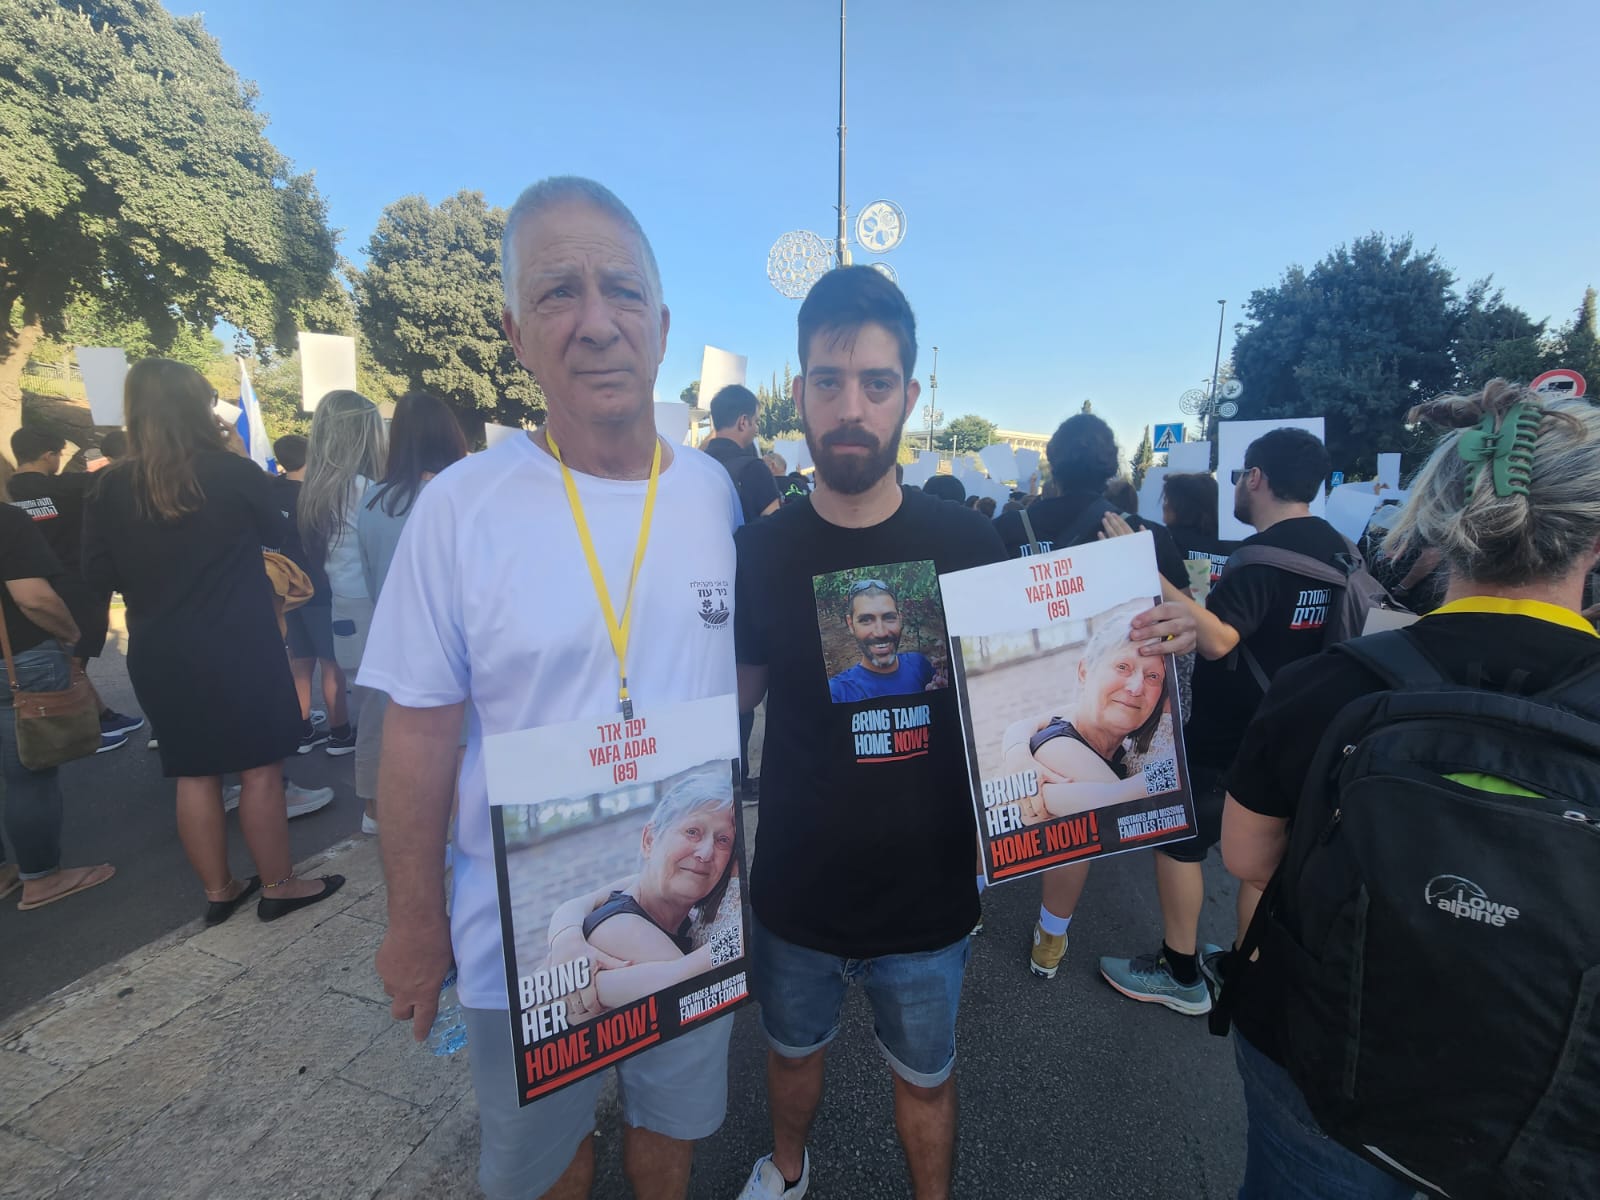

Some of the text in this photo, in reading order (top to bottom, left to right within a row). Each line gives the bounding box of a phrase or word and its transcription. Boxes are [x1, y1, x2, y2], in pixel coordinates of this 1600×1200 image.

[1029, 557, 1073, 582] יפה אדר
[697, 588, 713, 599] עוז
[1025, 575, 1085, 605] YAFA ADAR
[1047, 598, 1070, 621] (85)
[597, 718, 646, 743] יפה אדר
[851, 704, 931, 733] BRING TAMIR
[589, 736, 657, 767] YAFA ADAR
[854, 726, 929, 756] HOME NOW!
[613, 760, 638, 785] (85)
[982, 768, 1038, 809] BRING
[985, 803, 1023, 837] HER
[1117, 804, 1185, 827] HOSTAGES AND MISSING
[1119, 813, 1187, 839] FAMILIES FORUM
[990, 810, 1099, 867] HOME NOW!
[1437, 898, 1507, 927] alpine
[1457, 889, 1520, 919] Lowe
[519, 956, 591, 1011] BRING
[678, 971, 746, 1009] HOSTAGES AND MISSING
[680, 981, 748, 1023] FAMILIES FORUM
[521, 1000, 569, 1046] HER
[524, 996, 659, 1085] HOME NOW!
